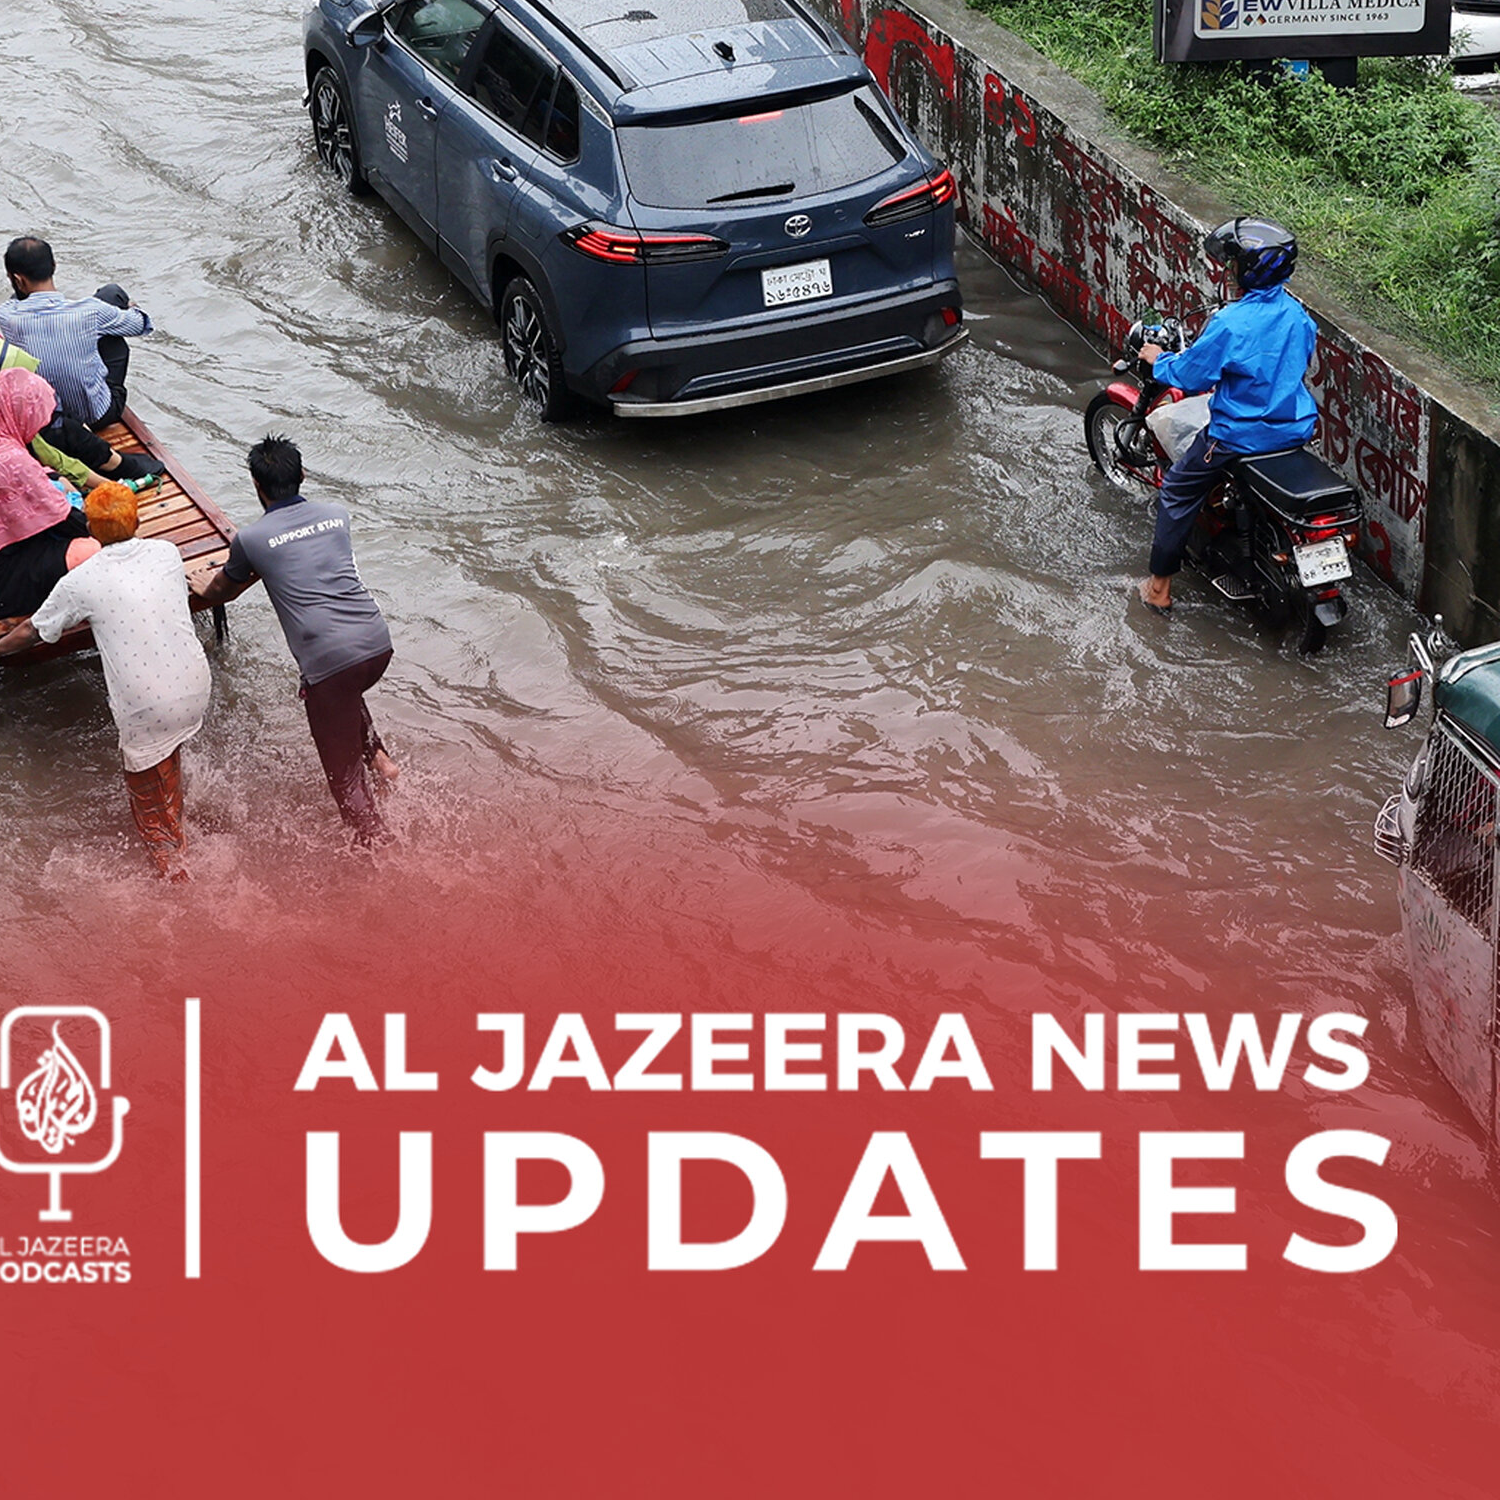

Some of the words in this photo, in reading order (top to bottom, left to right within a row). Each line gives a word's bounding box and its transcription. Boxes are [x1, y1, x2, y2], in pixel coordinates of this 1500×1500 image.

[1268, 13, 1328, 26] GERMANY
[1329, 12, 1361, 23] SINCE
[1365, 12, 1390, 22] 1963
[766, 275, 788, 287] ঢাকা
[789, 269, 815, 284] মেট্রো
[267, 525, 315, 549] SUPPORT
[316, 518, 344, 532] STAFF
